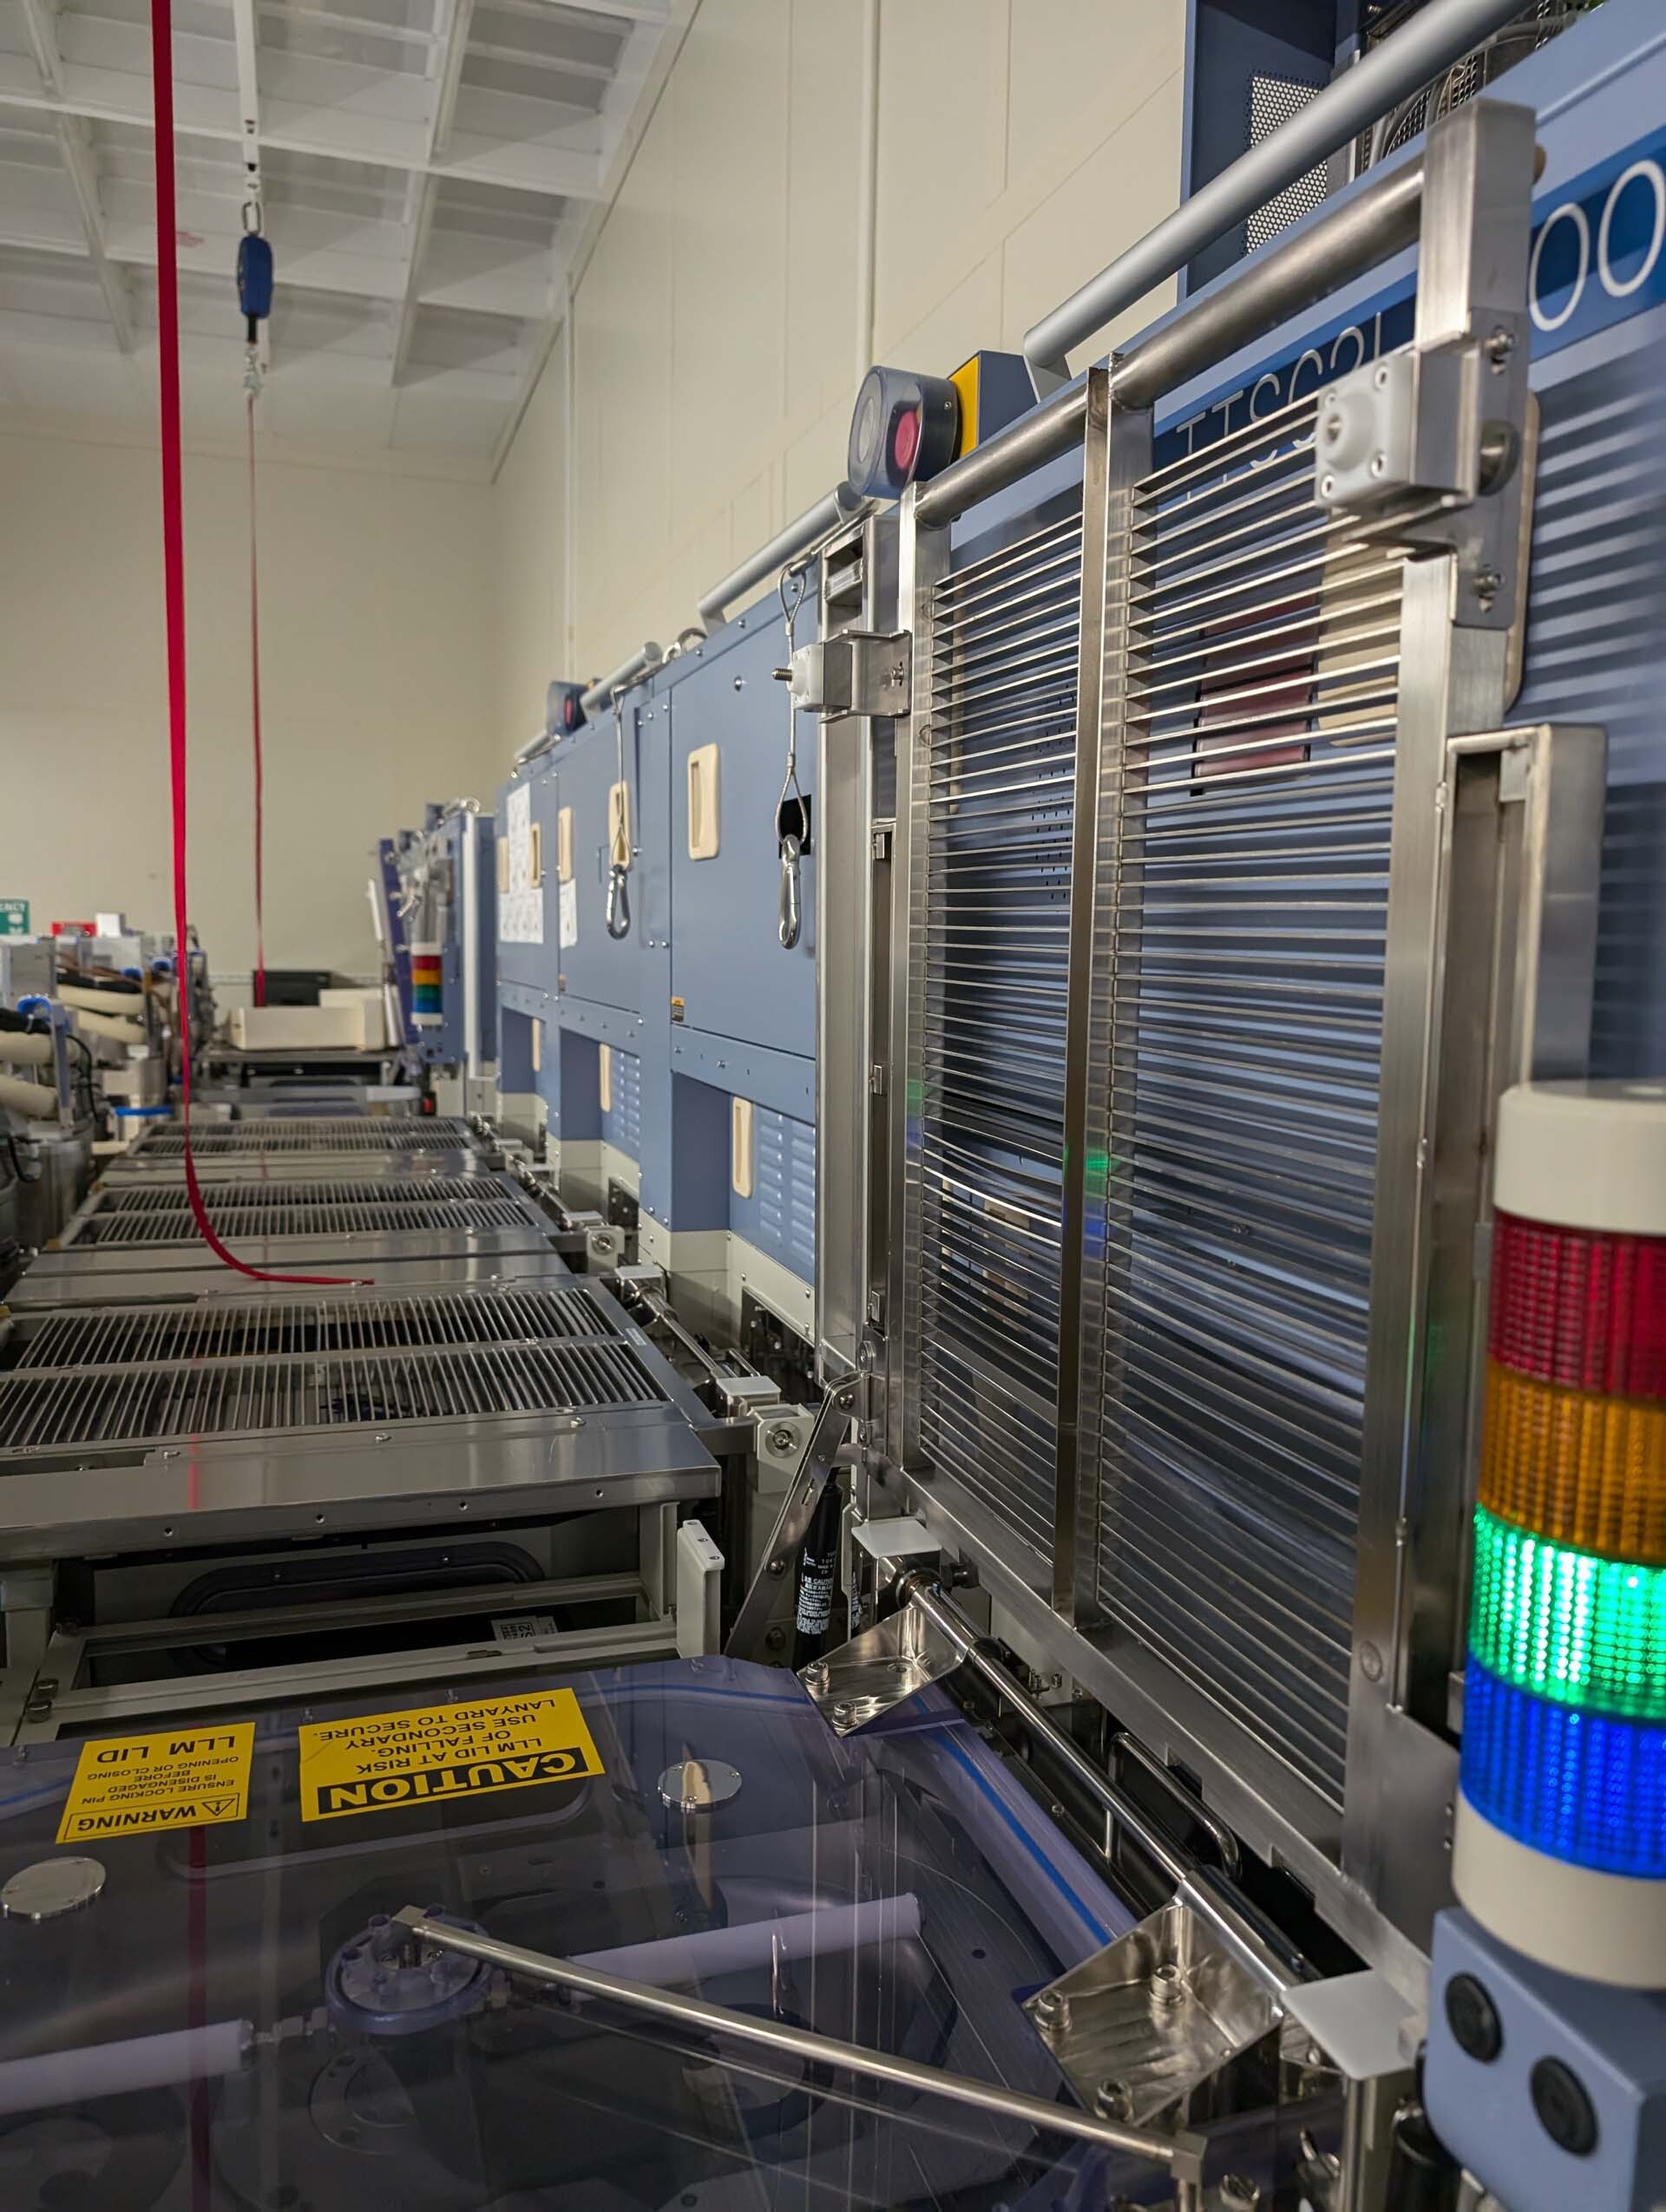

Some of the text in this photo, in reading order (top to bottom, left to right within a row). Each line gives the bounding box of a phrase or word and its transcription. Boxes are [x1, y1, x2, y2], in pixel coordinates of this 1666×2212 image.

[314, 1698, 556, 1741] LANYARD TO SECURE.
[346, 1714, 537, 1751] USE SECONDARY
[96, 1736, 236, 1764] LLM LID
[356, 1738, 541, 1775] LLM LID AT RISK
[371, 1730, 511, 1757] OF FALLING.
[88, 1756, 239, 1781] OPENING OR CLOSING
[134, 1770, 190, 1783] BEFORE
[330, 1752, 575, 1810] CAUTION
[82, 1779, 235, 1805] ENSURE LOCKING PIN
[108, 1777, 200, 1793] DISENGAGED
[77, 1805, 197, 1831] WARNING
